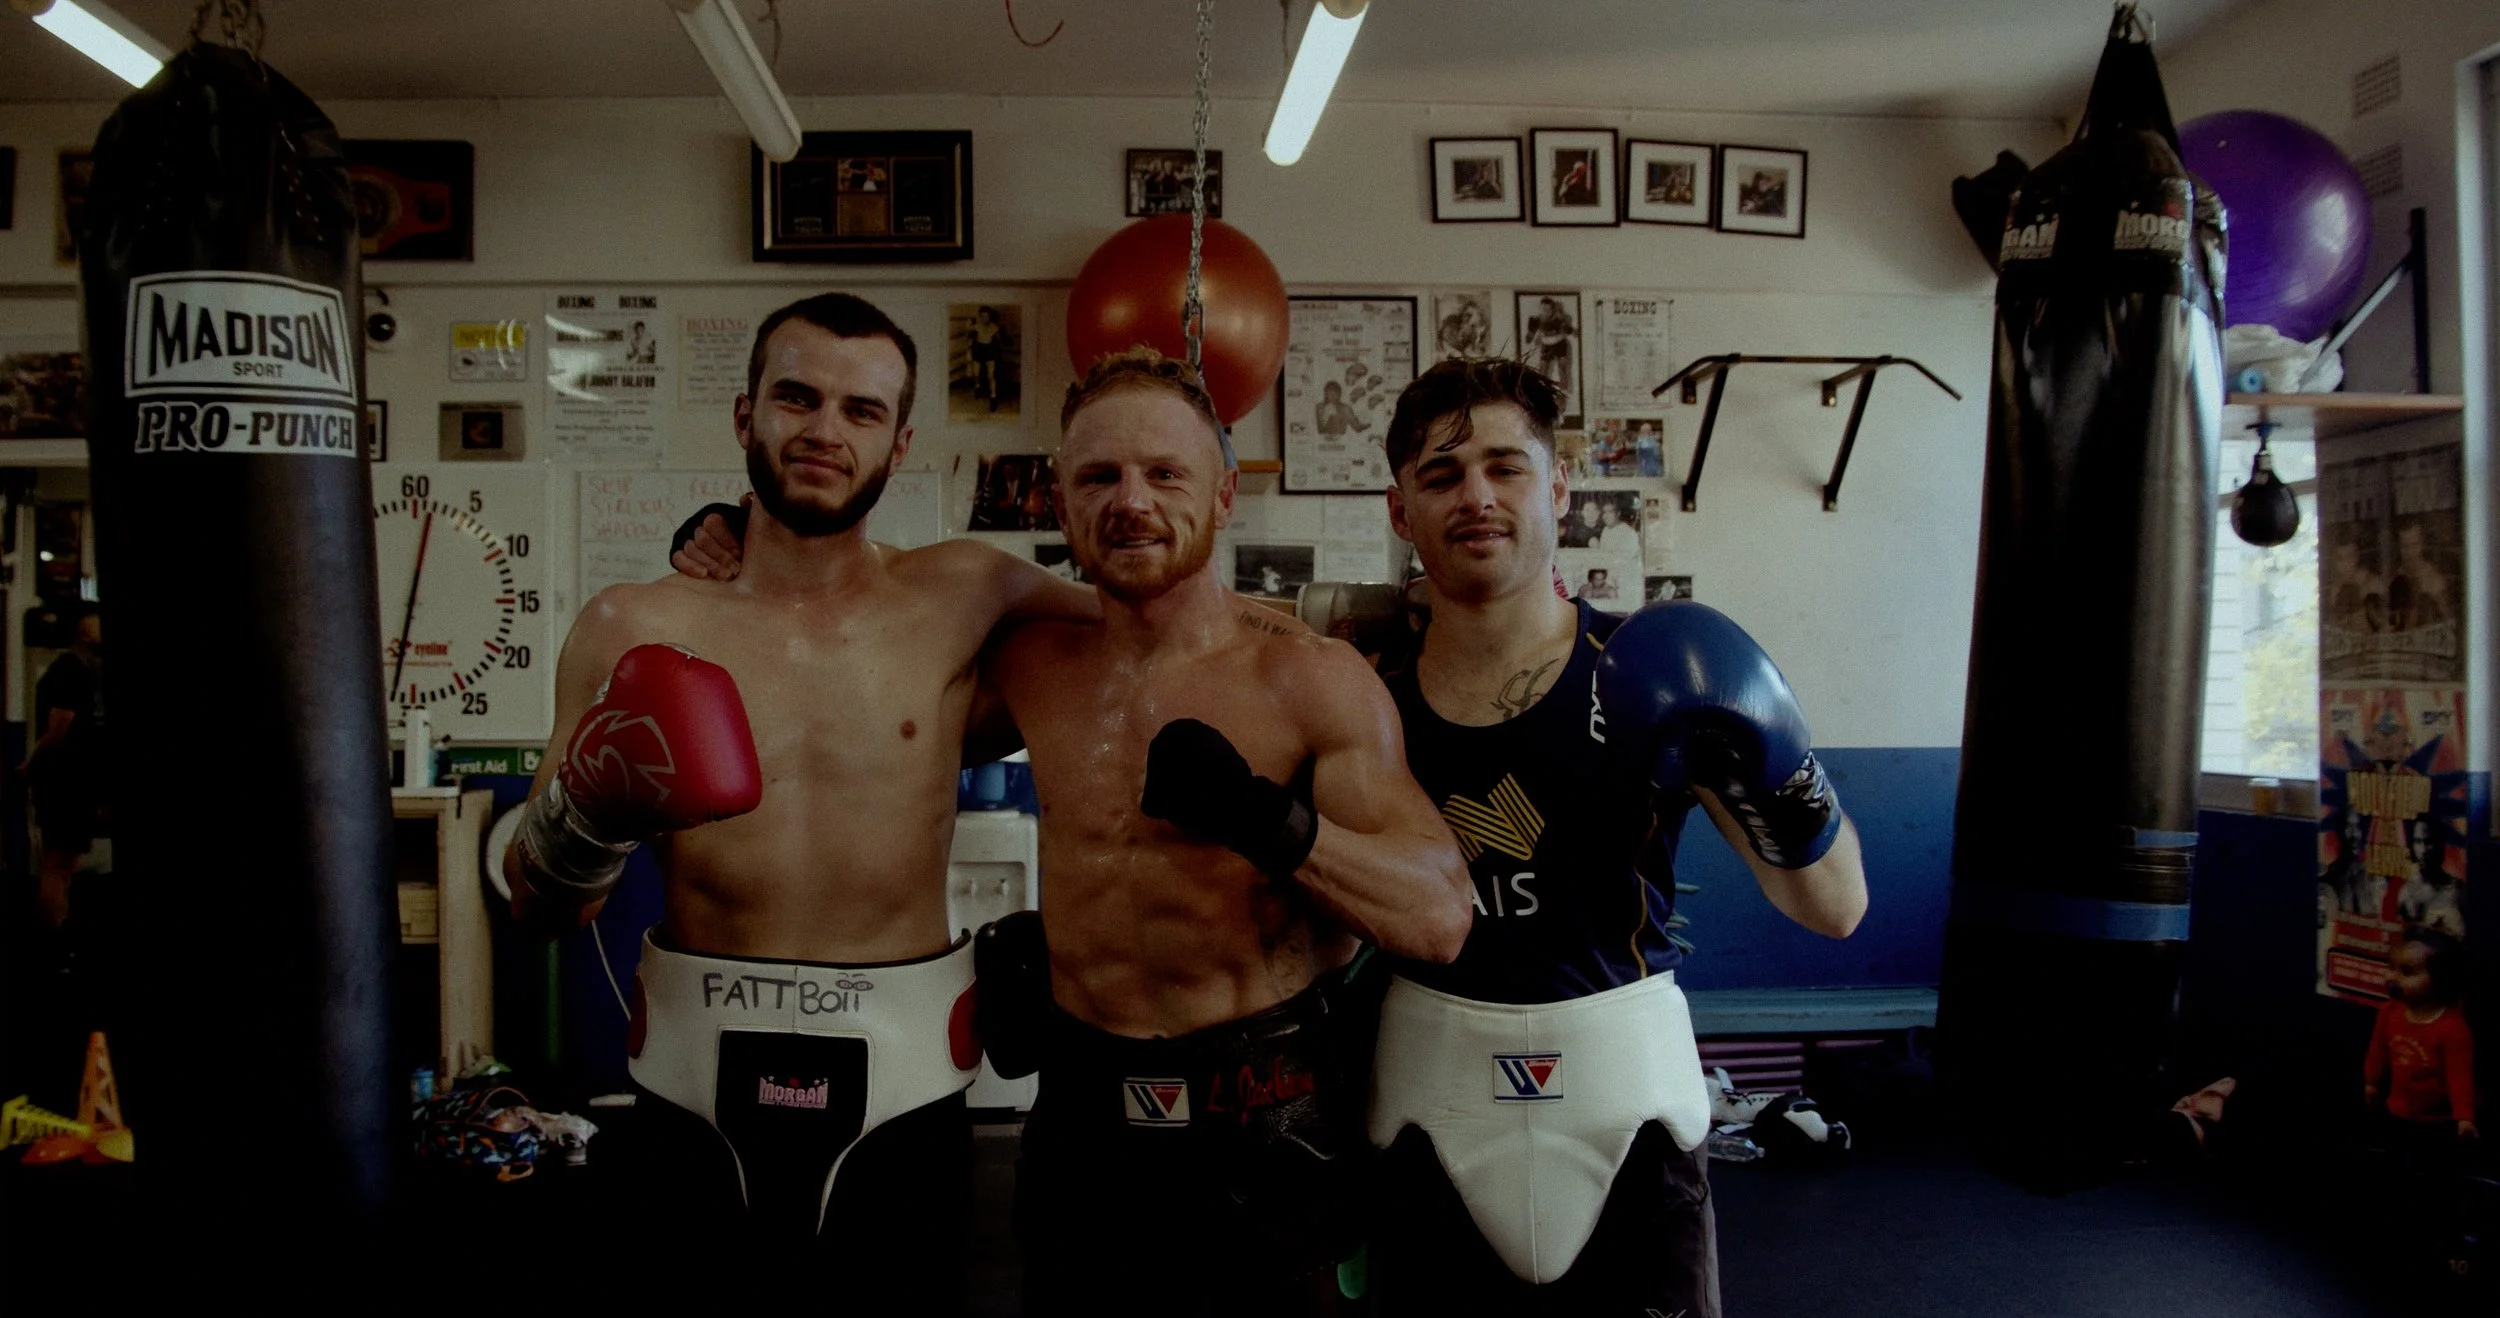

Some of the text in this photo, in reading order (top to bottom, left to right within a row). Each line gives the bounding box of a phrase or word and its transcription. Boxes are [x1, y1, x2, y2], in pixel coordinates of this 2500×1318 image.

[2114, 209, 2190, 239] MORG
[1613, 300, 1657, 314] BOXING
[686, 318, 748, 332] BOXING
[149, 291, 341, 384] MADISON
[233, 361, 284, 378] SPORT
[138, 404, 352, 450] PRO-PUNCH
[402, 476, 429, 498] 60
[470, 491, 482, 512] 5
[506, 535, 529, 557] 10
[518, 591, 539, 613] 15
[504, 646, 530, 668] 20
[462, 693, 488, 715] 25
[484, 759, 508, 774] Aid
[703, 973, 797, 1010] FATT
[759, 1077, 829, 1104] MORGAN
[2448, 1259, 2469, 1275] 10
